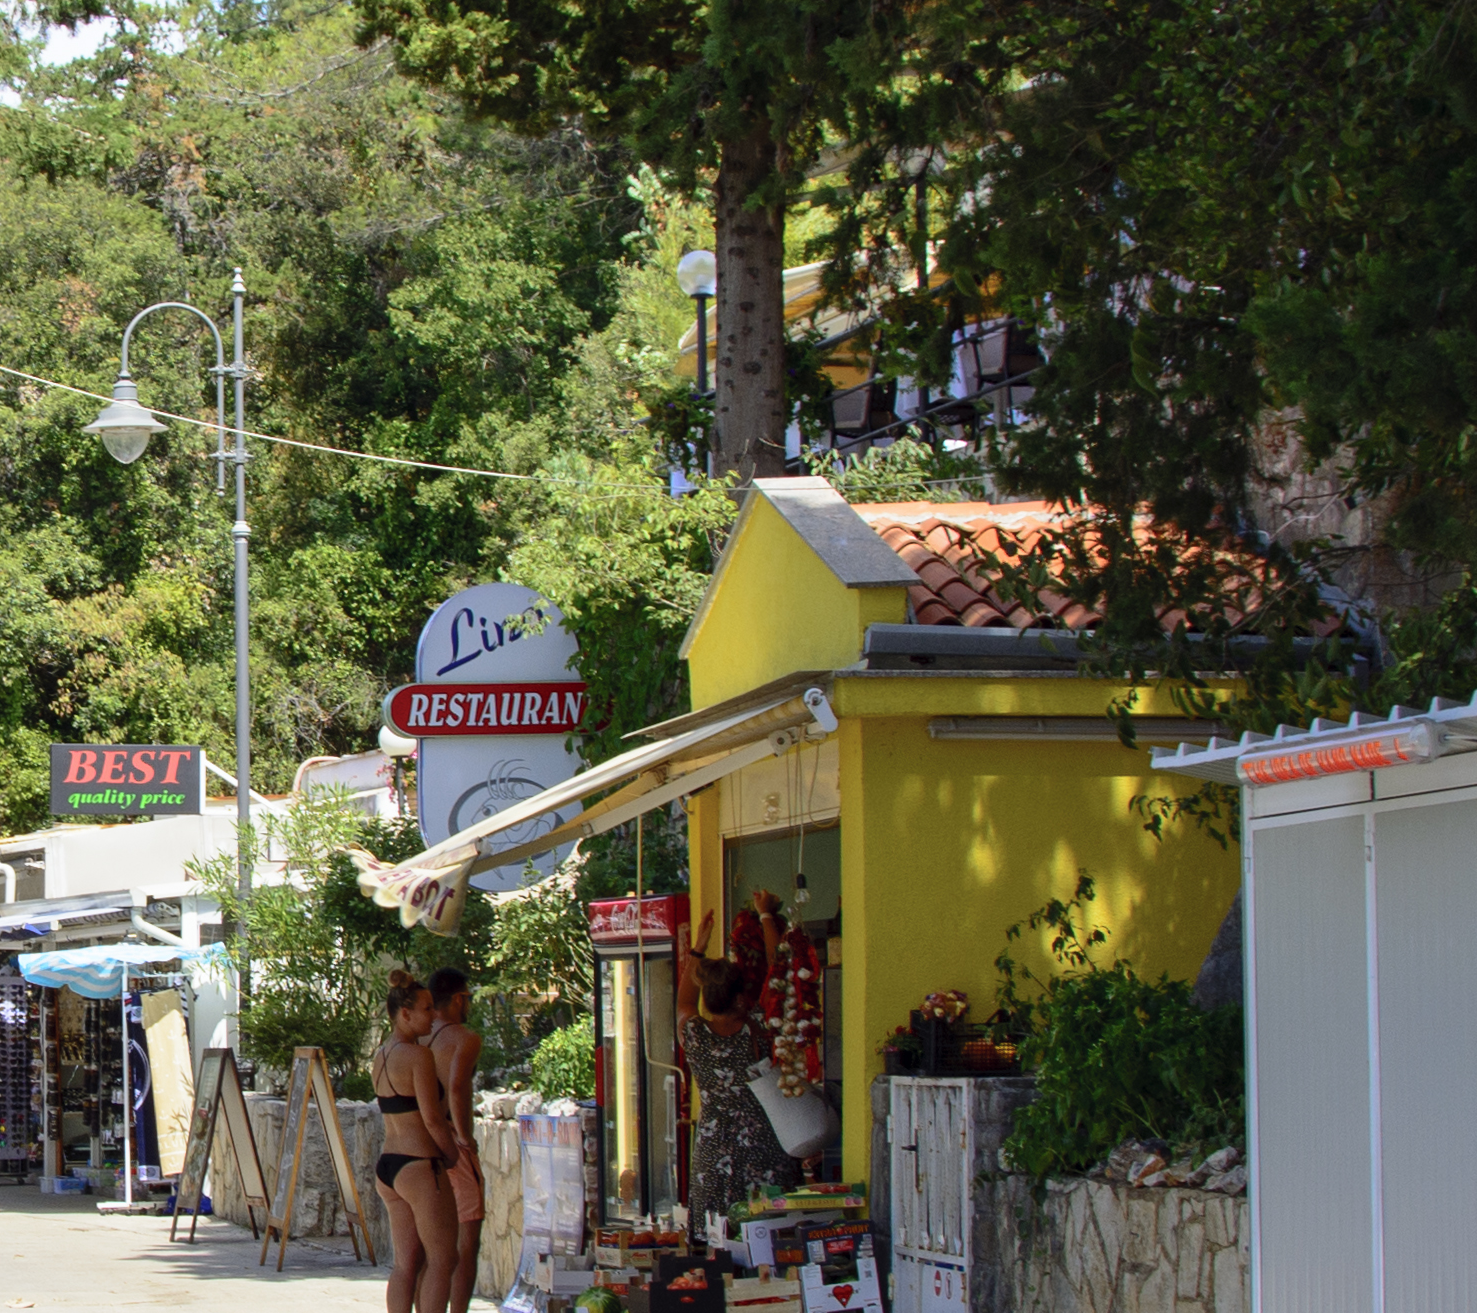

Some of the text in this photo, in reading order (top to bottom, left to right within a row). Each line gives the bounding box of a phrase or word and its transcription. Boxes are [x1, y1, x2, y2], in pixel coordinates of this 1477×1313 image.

[407, 691, 592, 728] RESTAURAN
[62, 750, 191, 784] BEST
[68, 789, 186, 809] quality price
